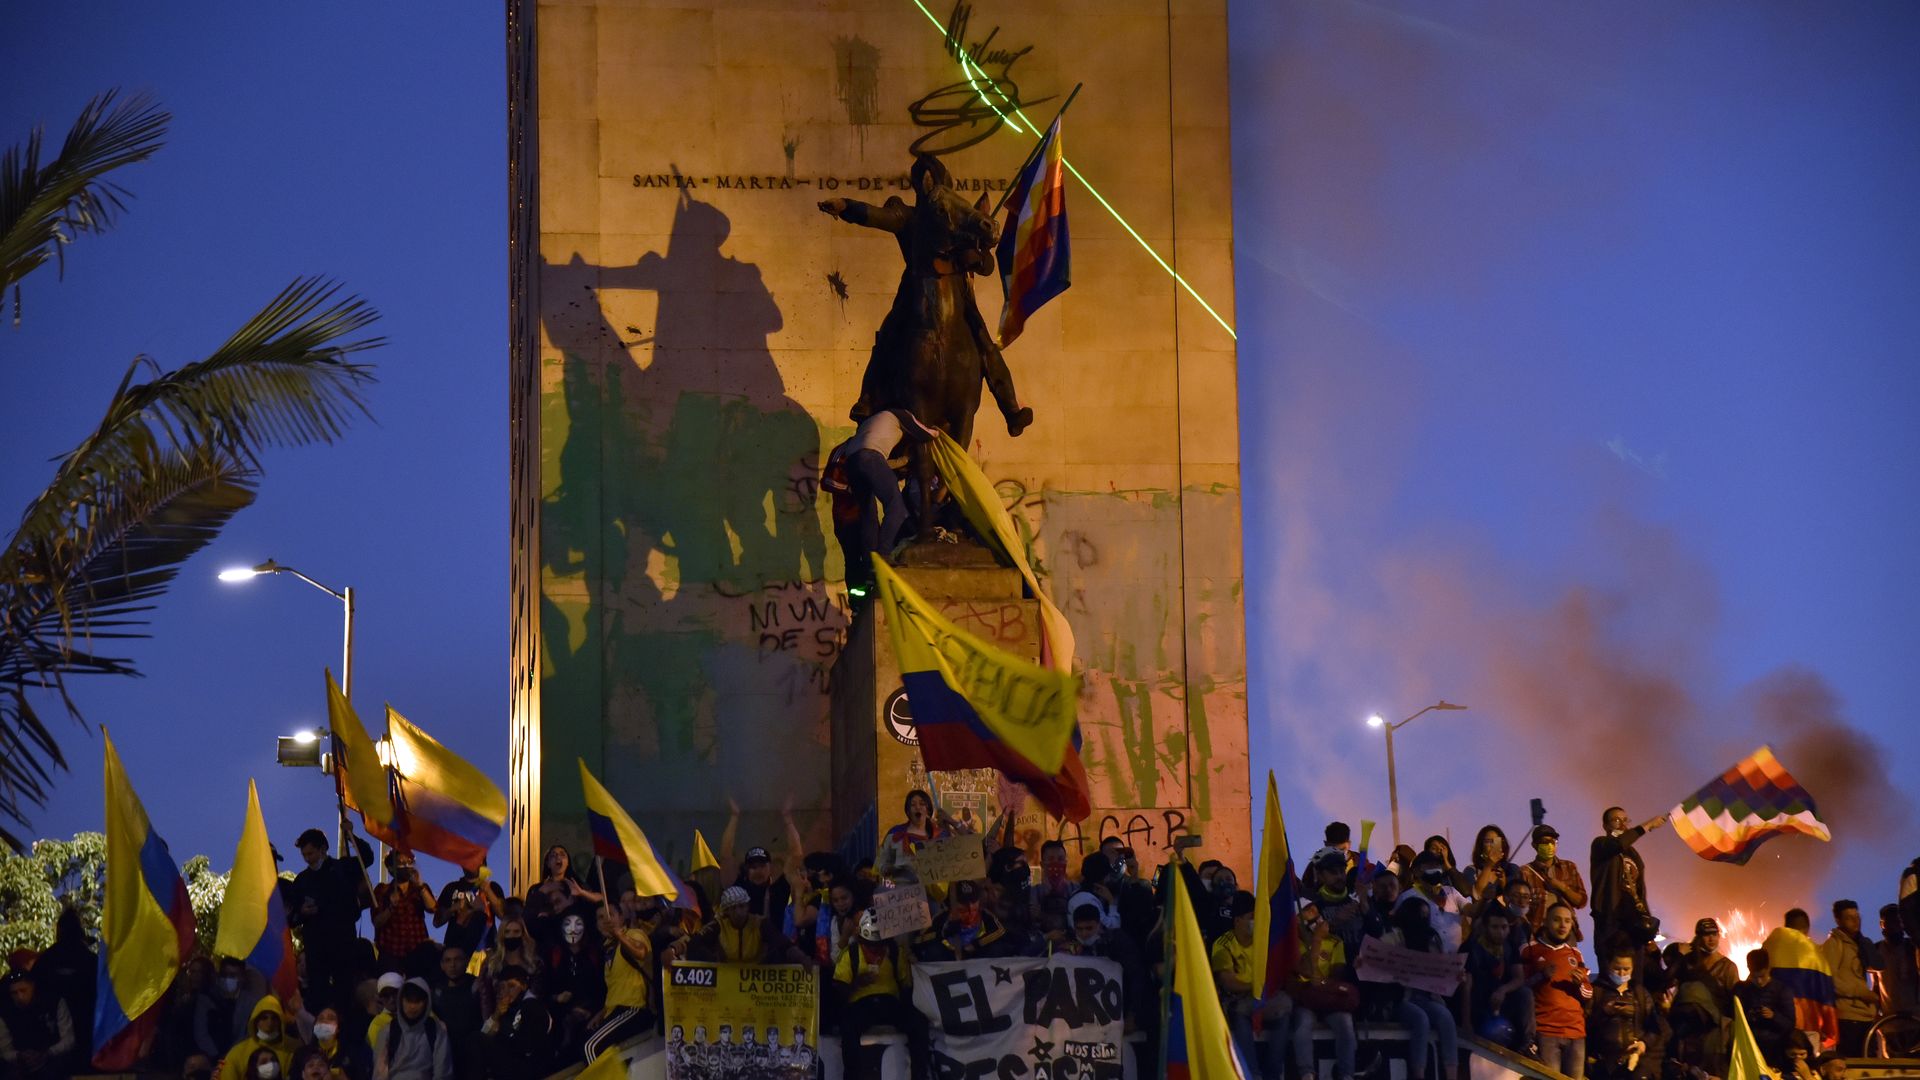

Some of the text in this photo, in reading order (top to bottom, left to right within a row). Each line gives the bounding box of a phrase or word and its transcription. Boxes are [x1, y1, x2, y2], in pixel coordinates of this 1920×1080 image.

[633, 174, 697, 189] SANTA
[717, 176, 792, 190] MARTA
[858, 178, 884, 190] DE
[900, 178, 1009, 192] DMBRE
[750, 600, 780, 632] NI
[788, 596, 830, 622] UN
[758, 627, 805, 655] DE
[675, 968, 713, 985] 6.402
[739, 968, 814, 983] URIBE DIO
[738, 982, 814, 995] LA ORDEN
[930, 966, 1122, 1036] EL PARO
[1065, 1043, 1089, 1058] NOS
